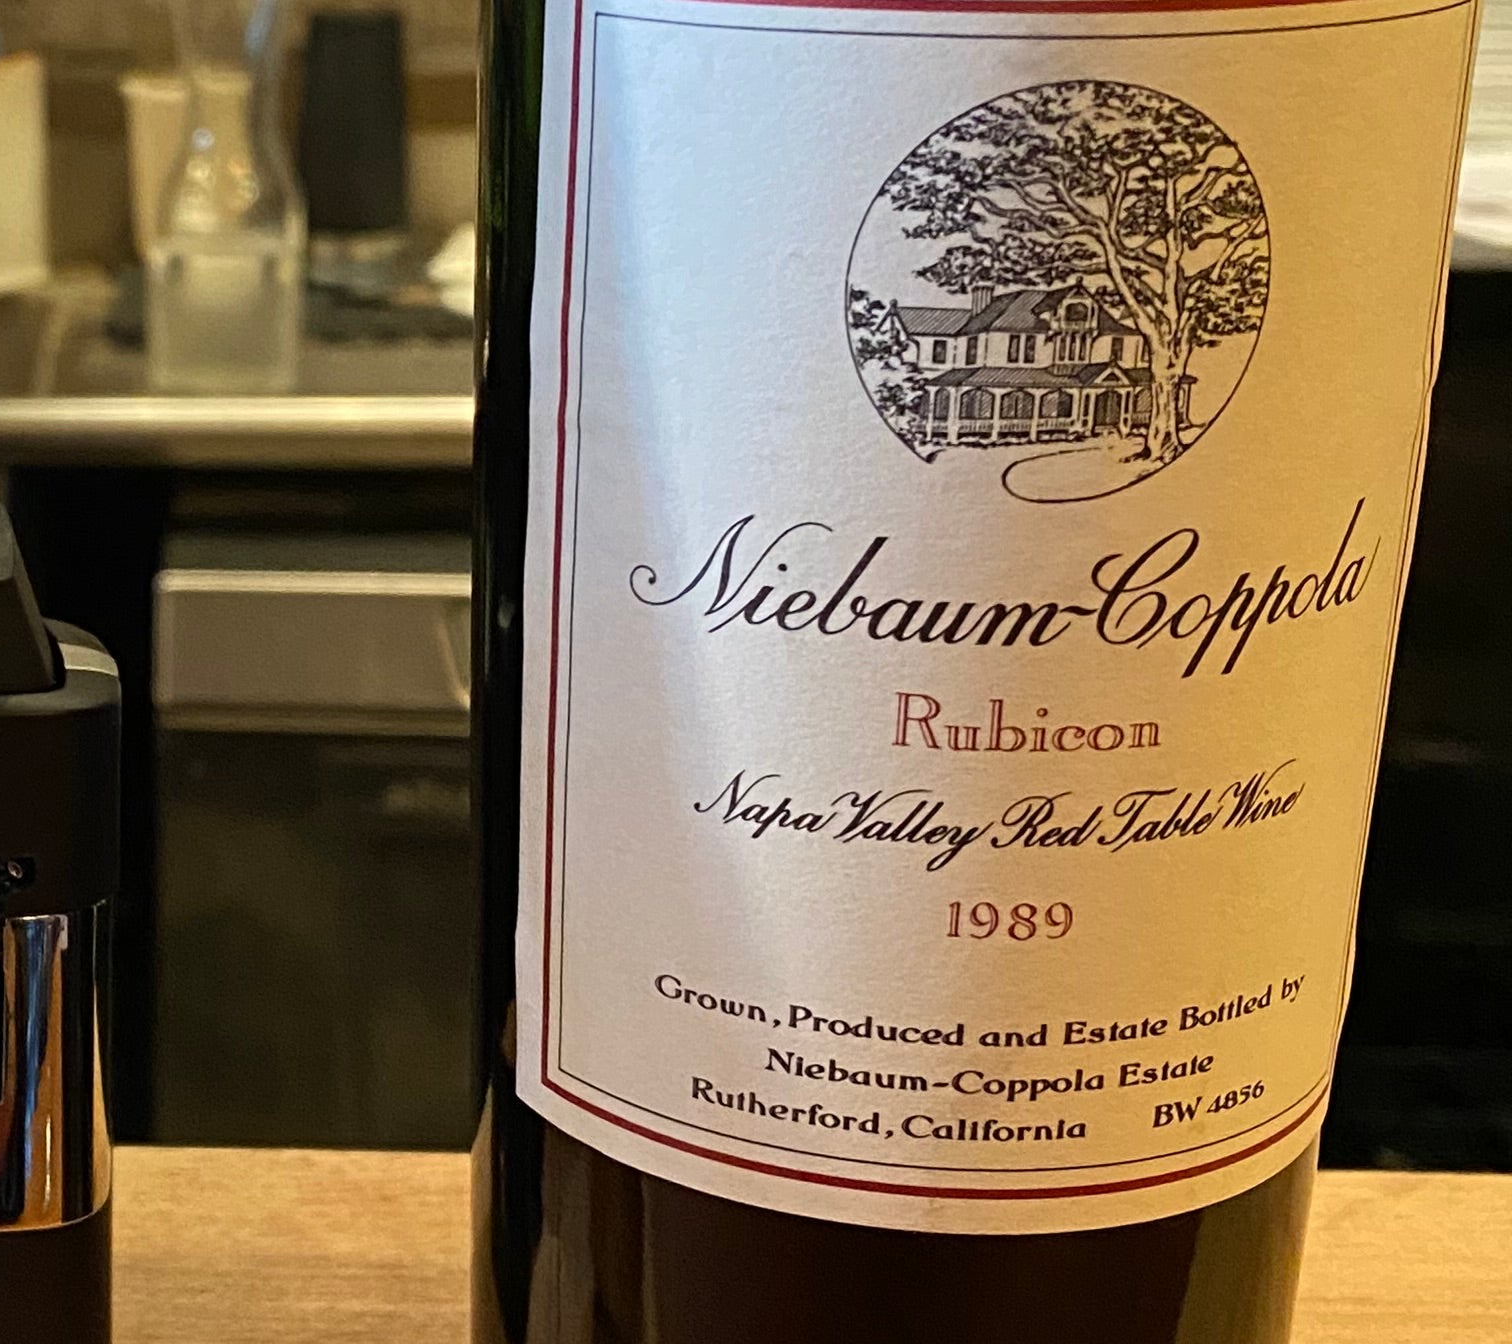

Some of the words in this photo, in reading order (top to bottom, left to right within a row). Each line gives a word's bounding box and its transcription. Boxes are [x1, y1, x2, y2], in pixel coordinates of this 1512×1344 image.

[629, 496, 1381, 679] Niebaum-Coppola
[891, 691, 1162, 754] Rubicon
[693, 769, 838, 839] Napa
[830, 788, 994, 872] Valley
[990, 790, 1104, 849] Red
[1096, 787, 1224, 854] Table
[1217, 758, 1306, 831] Wine
[945, 900, 1074, 942] 1989
[654, 974, 782, 1029] Grown,
[788, 1004, 965, 1047] Produced
[978, 1023, 1048, 1048] and
[1062, 1018, 1169, 1046] Estate
[1178, 983, 1273, 1032] Bottled
[1280, 974, 1305, 1003] by
[764, 1047, 1105, 1102] Niebaum-Coppola
[1117, 1055, 1215, 1088] Estate
[691, 1076, 894, 1140] Rutherford,
[900, 1113, 1087, 1142] California
[1151, 1096, 1204, 1129] BW
[1206, 1079, 1266, 1115] 4856
